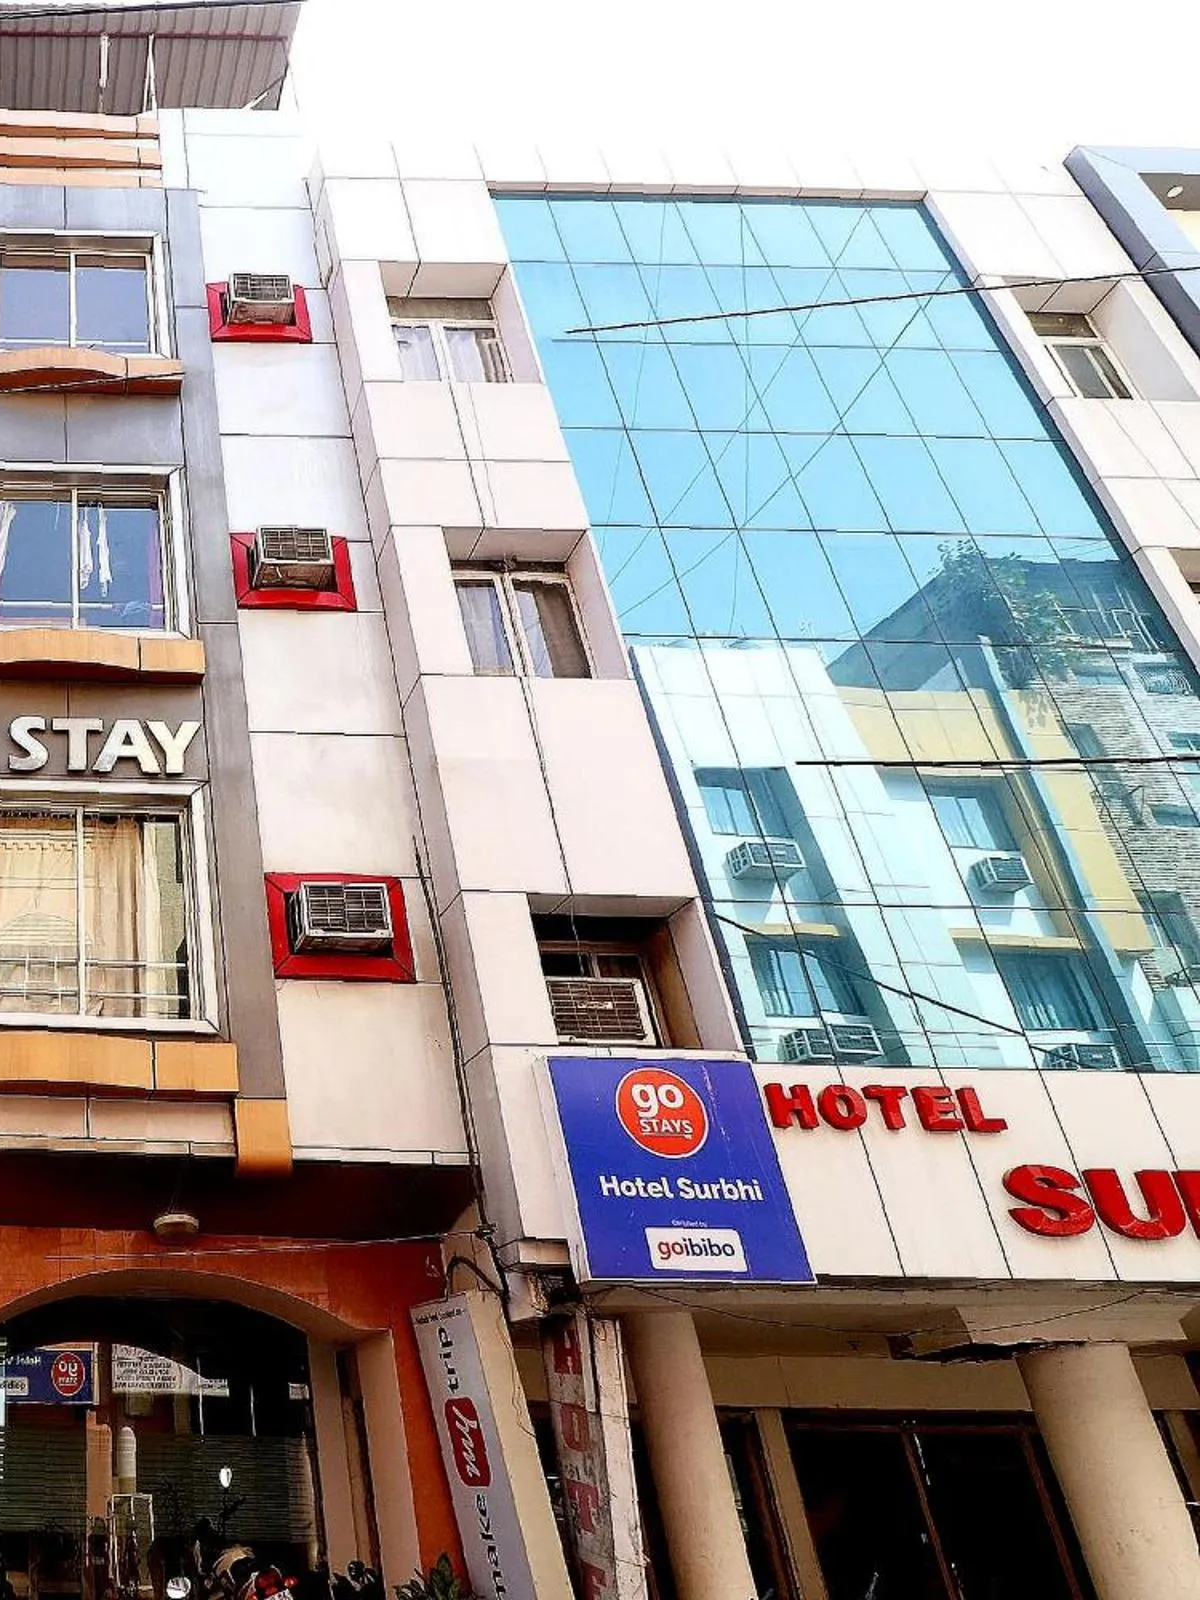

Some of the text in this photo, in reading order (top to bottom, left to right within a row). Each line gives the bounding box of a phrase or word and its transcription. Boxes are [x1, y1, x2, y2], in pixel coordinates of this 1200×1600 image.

[7, 715, 202, 775] STAY
[631, 1083, 684, 1118] go
[763, 1083, 1008, 1133] HOTEL
[640, 1119, 694, 1135] STAYS
[599, 1175, 764, 1201] Hotel Surbhi
[657, 1238, 736, 1260] goibibo
[437, 1326, 459, 1394] trip
[452, 1405, 482, 1478] my
